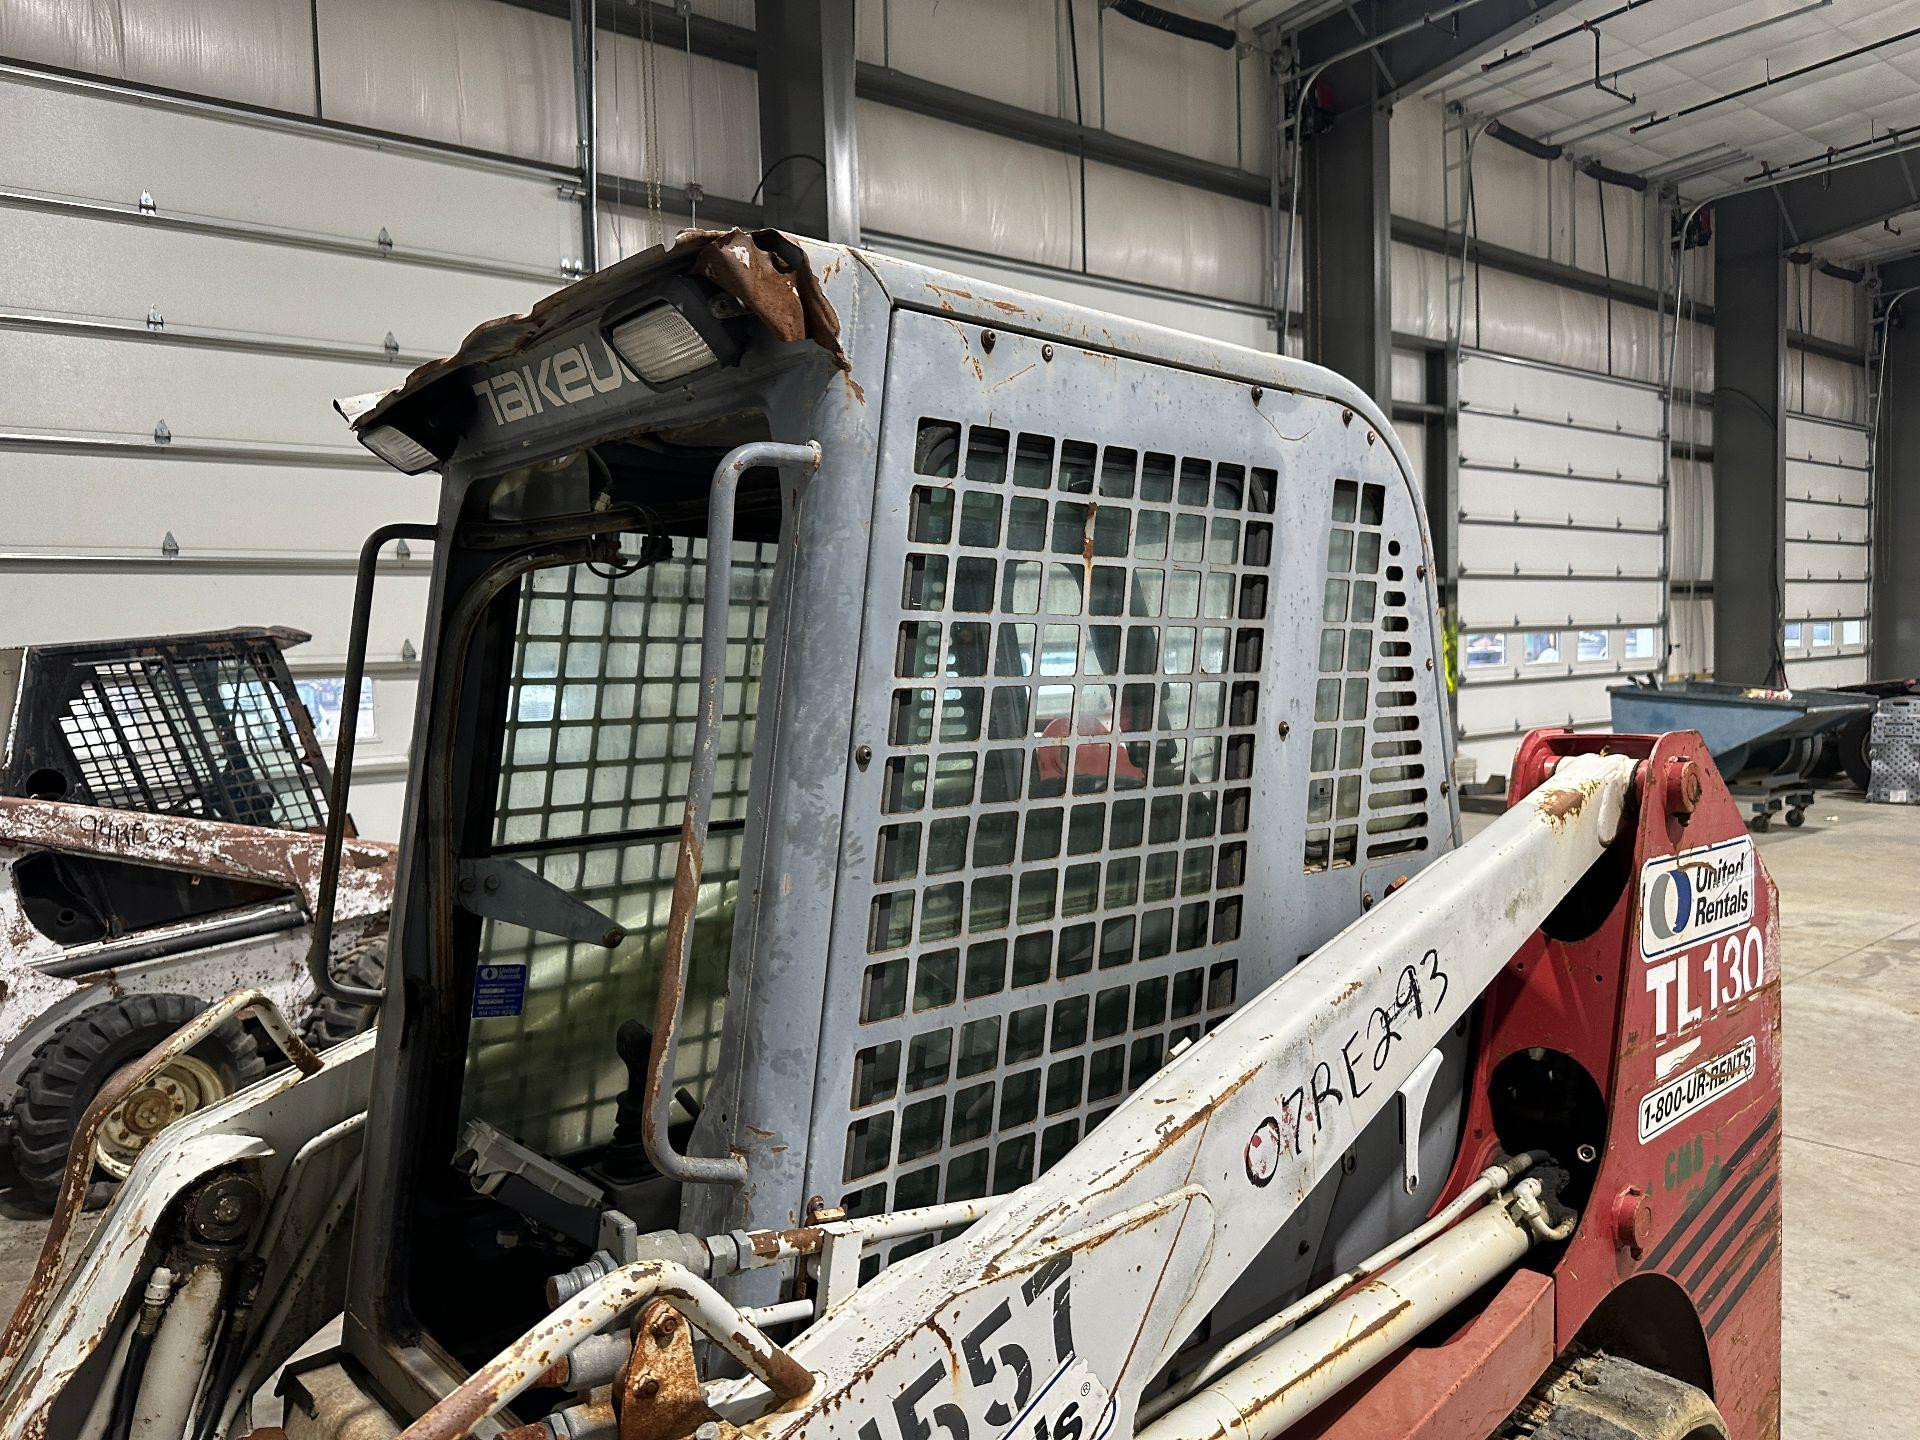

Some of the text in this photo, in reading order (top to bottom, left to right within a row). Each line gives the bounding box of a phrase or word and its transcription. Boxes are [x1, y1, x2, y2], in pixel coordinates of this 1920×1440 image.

[1695, 852, 1745, 893] United
[1694, 885, 1749, 927] Rentals
[855, 1250, 1076, 1440] 557
